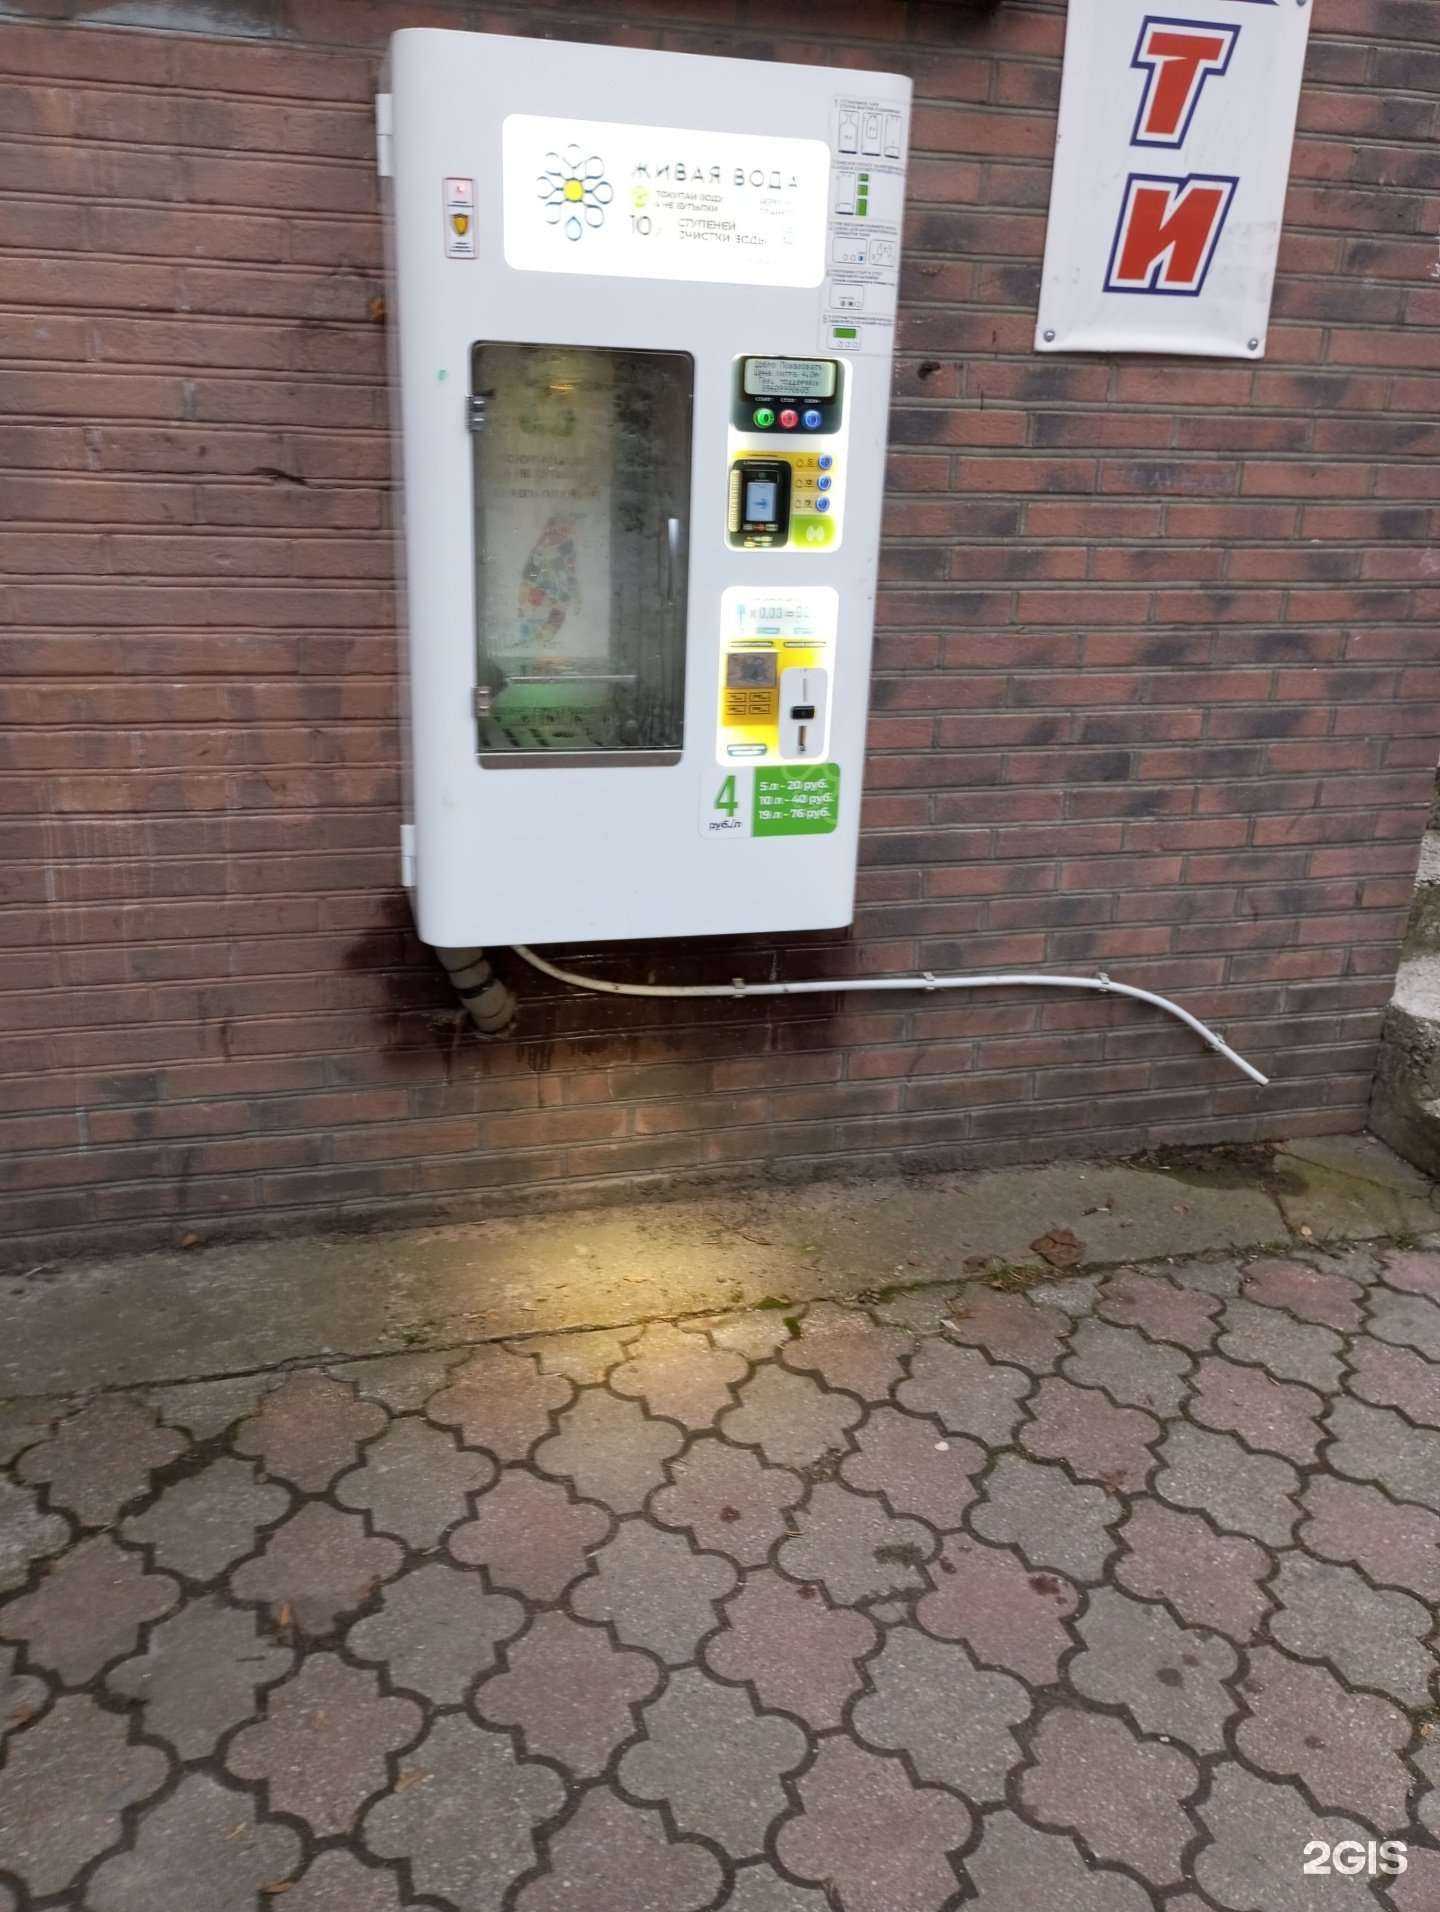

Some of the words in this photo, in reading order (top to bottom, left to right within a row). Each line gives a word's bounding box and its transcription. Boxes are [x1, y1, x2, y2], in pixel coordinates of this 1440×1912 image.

[632, 162, 721, 184] ЖИВАЯ
[733, 167, 798, 190] ВОДА
[628, 214, 652, 236] 10
[679, 218, 736, 232] СТУПЕНЕЙ
[787, 780, 803, 790] 20
[714, 775, 738, 817] 4
[759, 810, 772, 820] 19
[790, 808, 806, 818] 76
